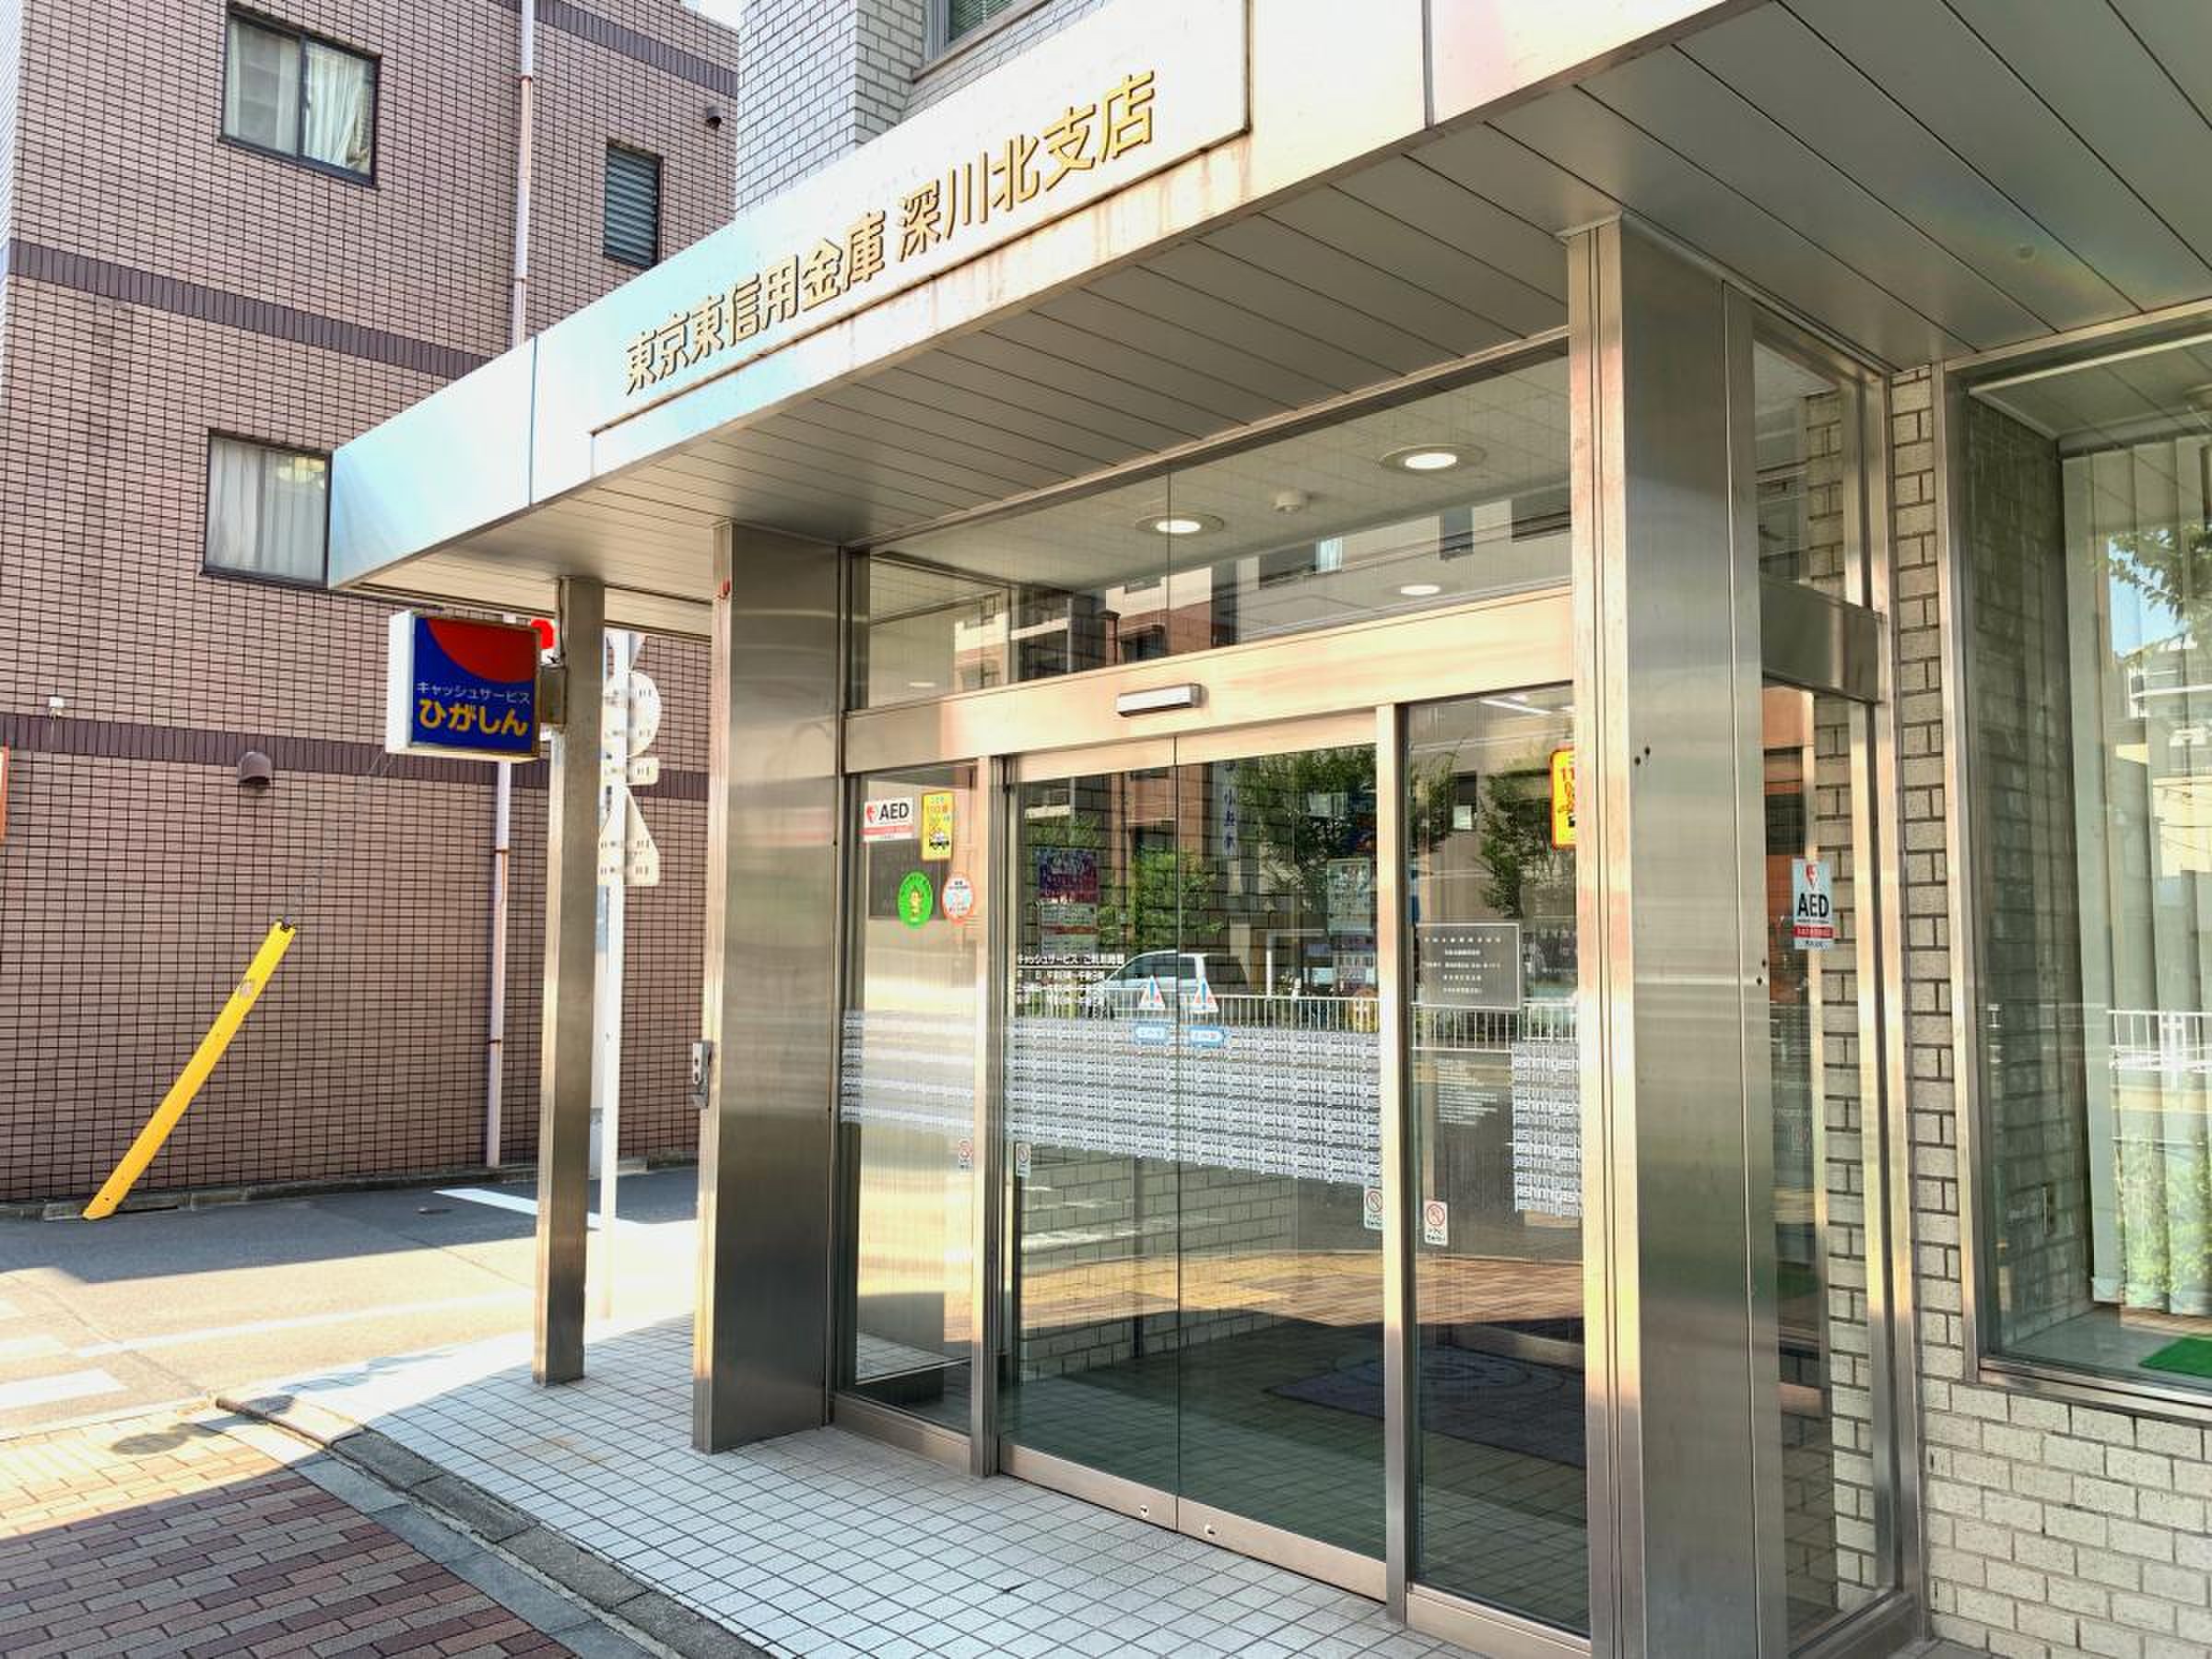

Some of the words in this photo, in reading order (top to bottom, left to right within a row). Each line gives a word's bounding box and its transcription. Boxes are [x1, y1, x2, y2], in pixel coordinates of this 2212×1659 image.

[626, 209, 888, 396] 東京東信用金庫
[897, 70, 1157, 264] 深川北支店
[417, 681, 531, 705] キャッシュサービス
[418, 699, 529, 736] ひがしん
[878, 802, 910, 821] AED
[1797, 892, 1830, 918] AED
